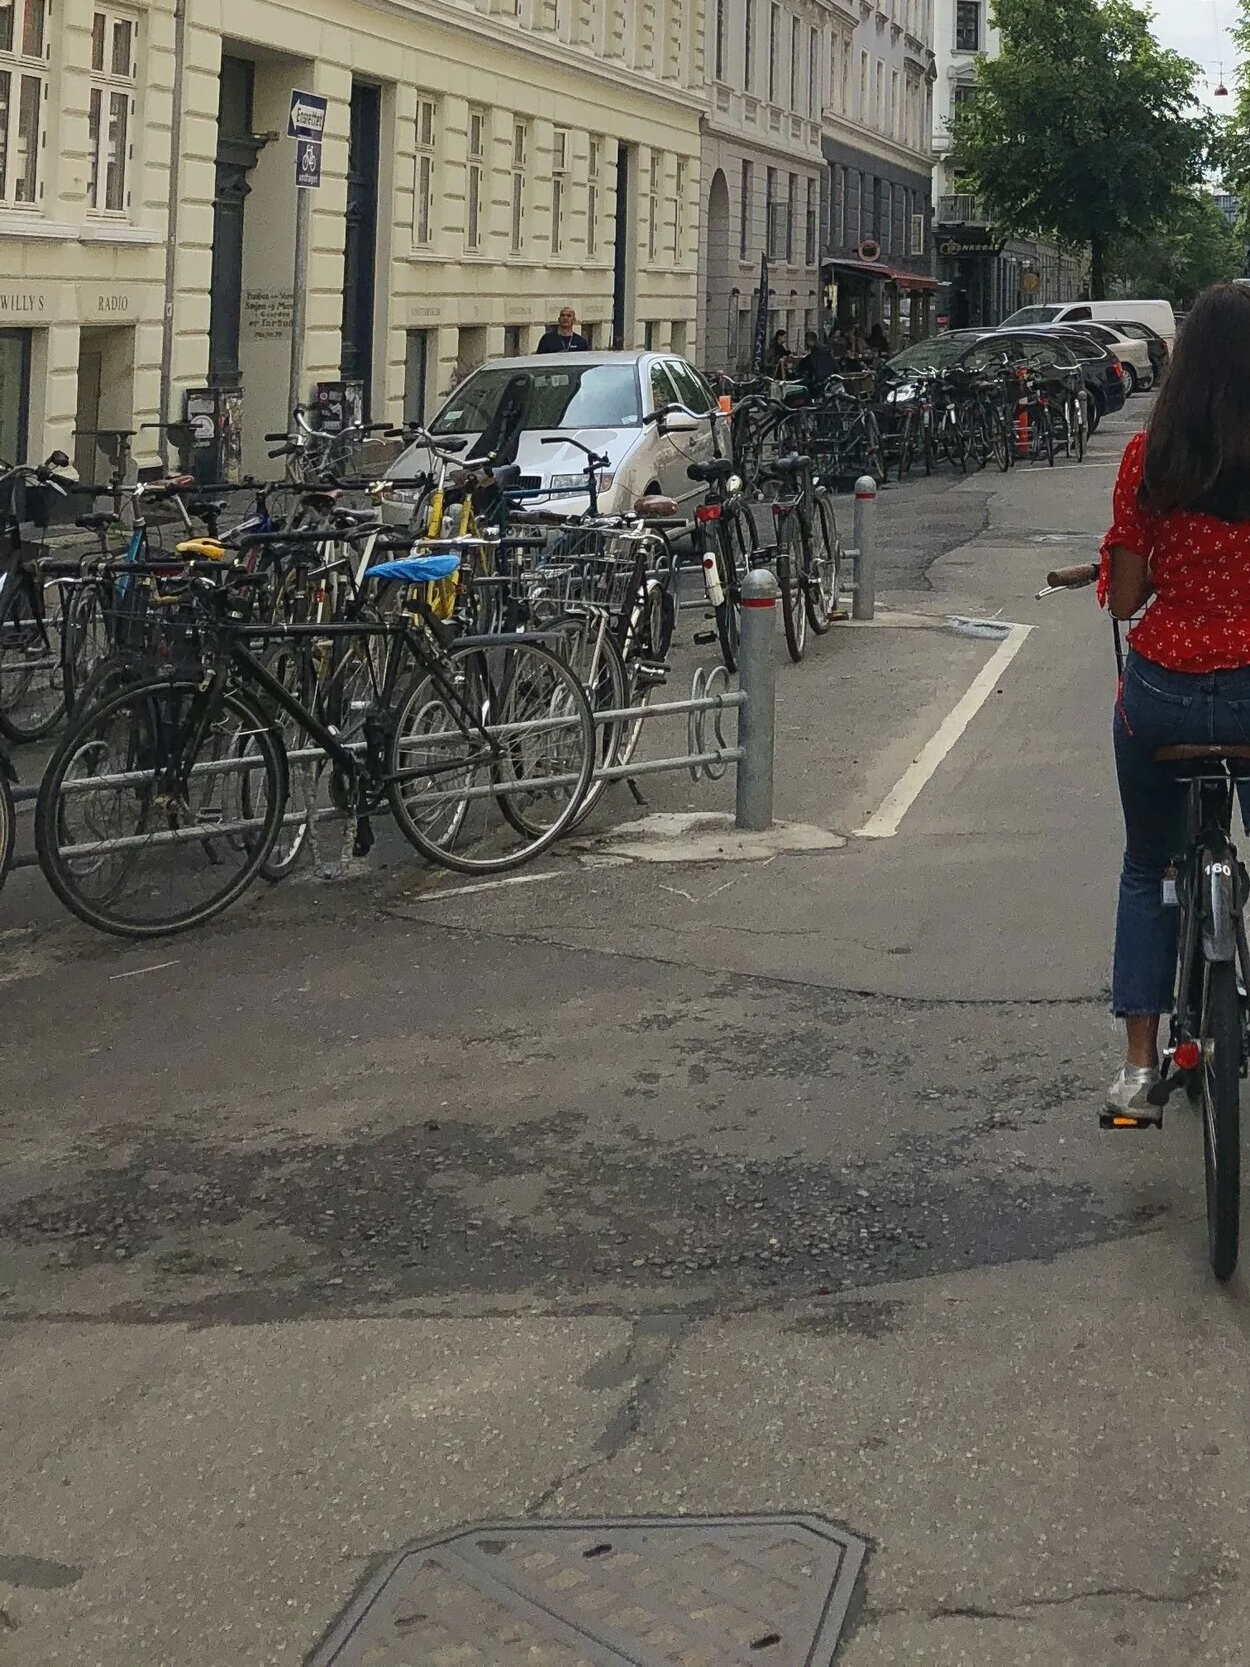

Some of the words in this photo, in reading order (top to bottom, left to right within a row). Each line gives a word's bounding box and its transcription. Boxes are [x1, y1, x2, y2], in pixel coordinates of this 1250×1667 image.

[296, 107, 323, 127] Ensrettet
[98, 295, 129, 311] RADIO
[1204, 863, 1231, 876] 160
